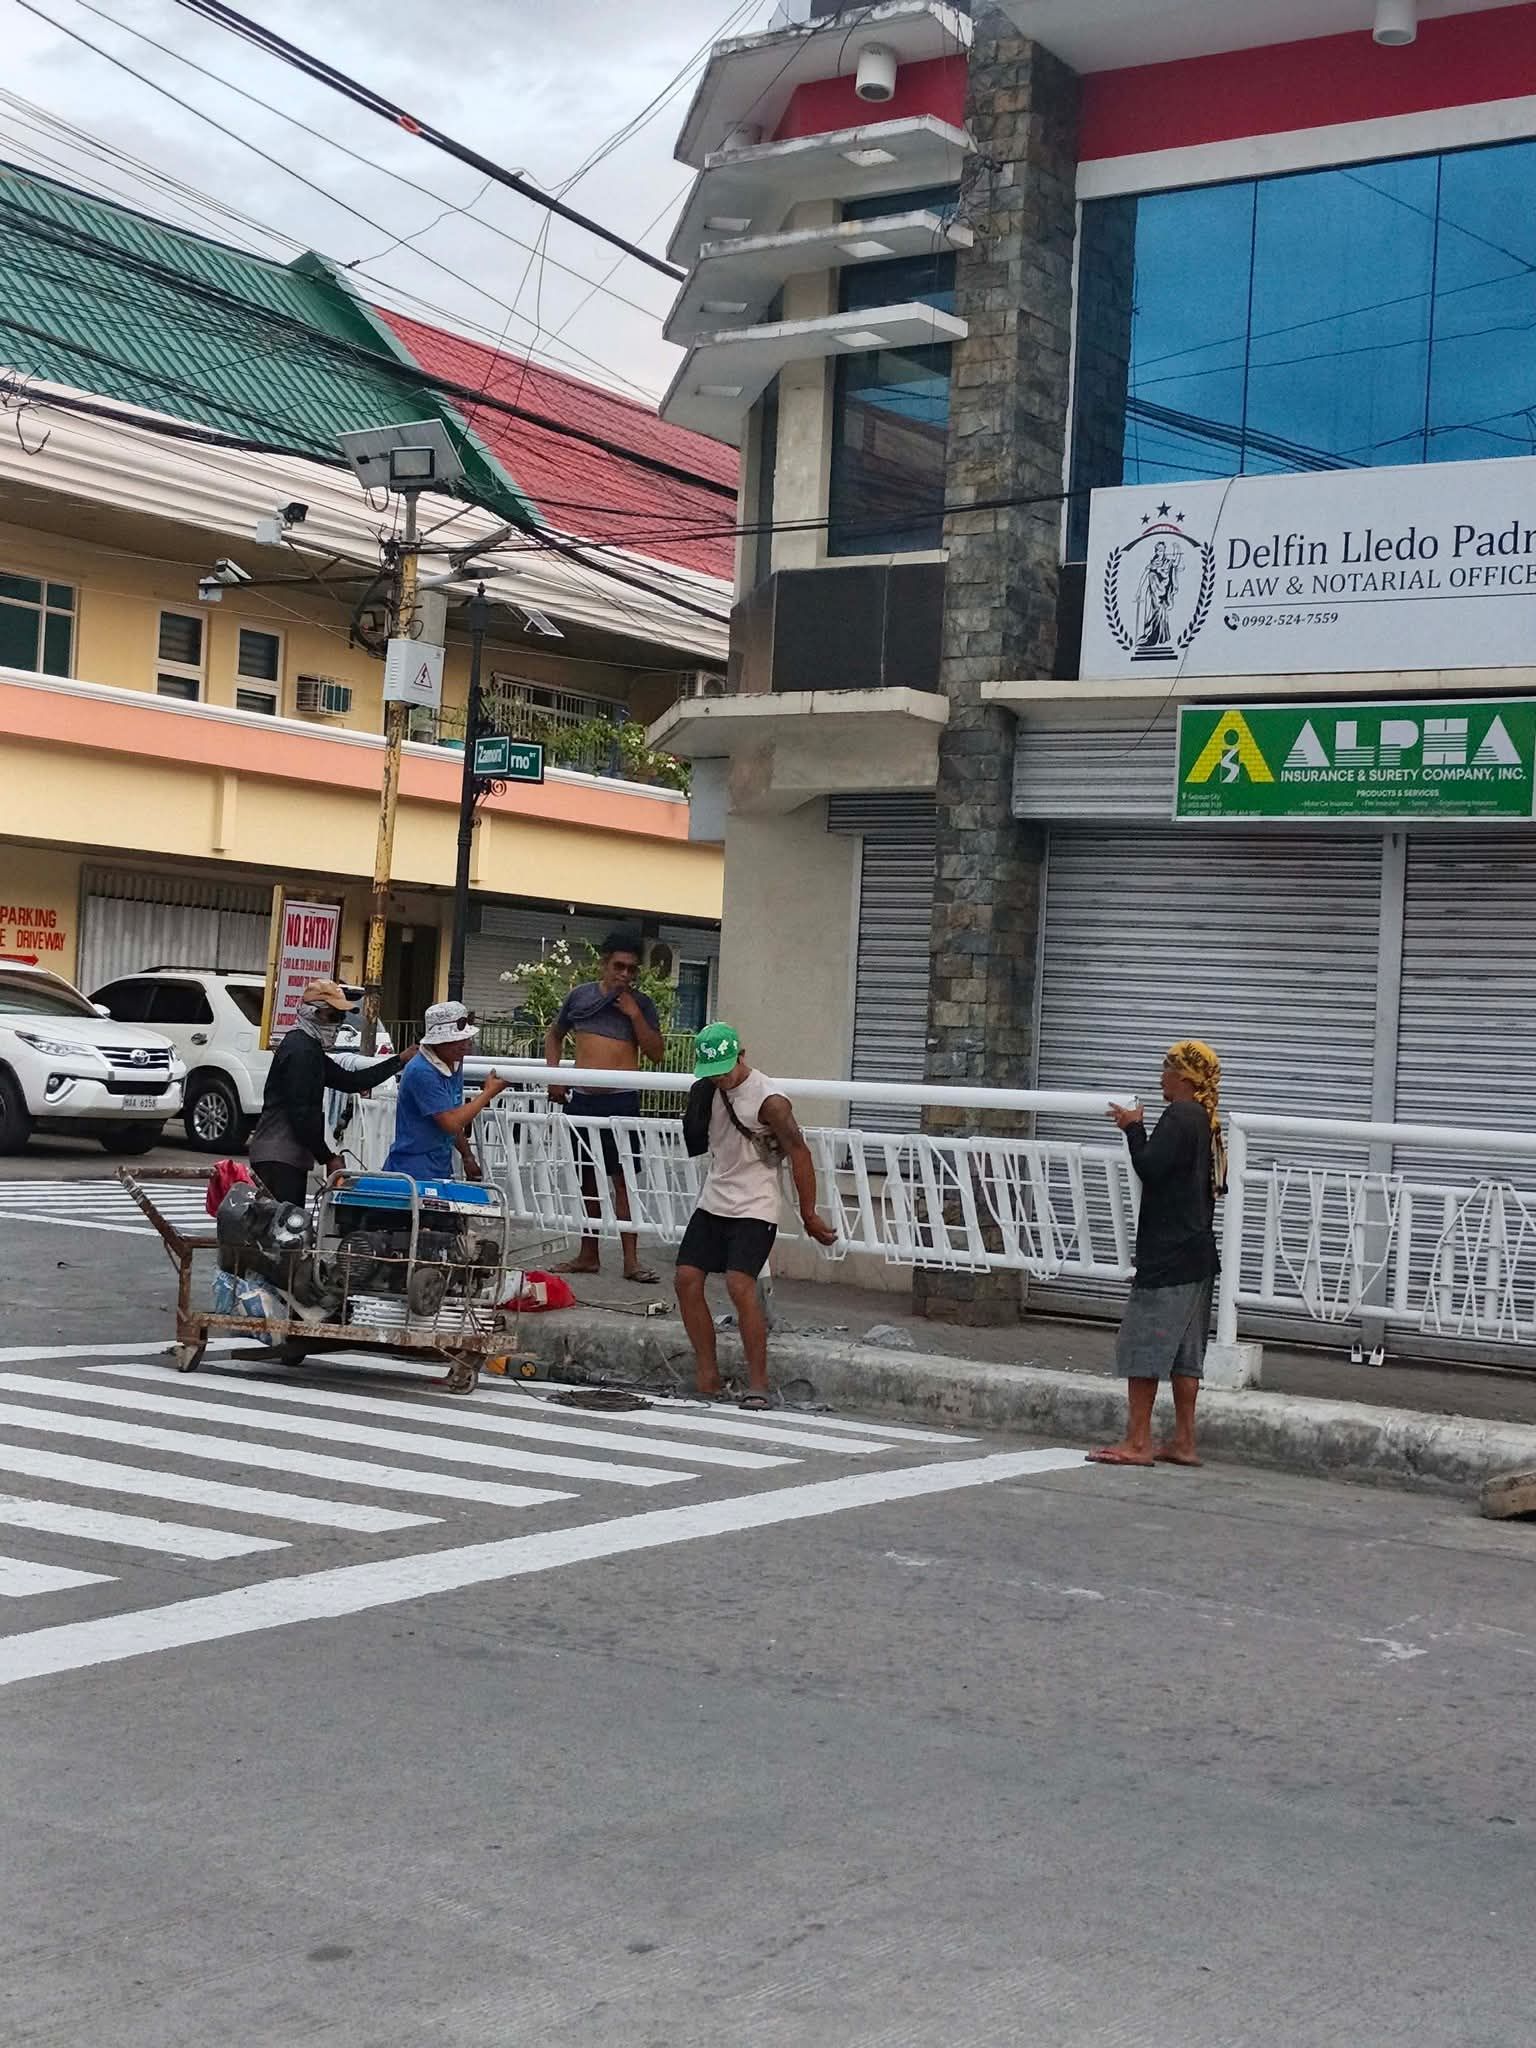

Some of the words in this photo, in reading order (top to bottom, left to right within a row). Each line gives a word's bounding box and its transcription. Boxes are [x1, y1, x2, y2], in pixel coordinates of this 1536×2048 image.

[1227, 533, 1328, 570] Delfin
[1341, 526, 1438, 563] Lledo
[1226, 577, 1279, 598] LAW
[1286, 575, 1304, 595] &
[1312, 568, 1441, 594] NOTARIAL
[1449, 564, 1536, 588] OFFICE
[1242, 612, 1339, 627] 0992-524-7559
[1283, 714, 1522, 767] ALPHA
[1281, 769, 1355, 782] INSURANCE
[1357, 769, 1367, 781] &
[1369, 768, 1419, 781] SURETY
[1422, 767, 1495, 782] COMPANY,
[1498, 766, 1527, 780] INC.
[1356, 789, 1396, 797] PRODUCTS
[1403, 789, 1439, 797] SERVICES
[0, 906, 57, 928] PARKING
[16, 929, 66, 951] DRIVEWAY
[286, 913, 302, 947] NO
[302, 915, 335, 950] ENTRY
